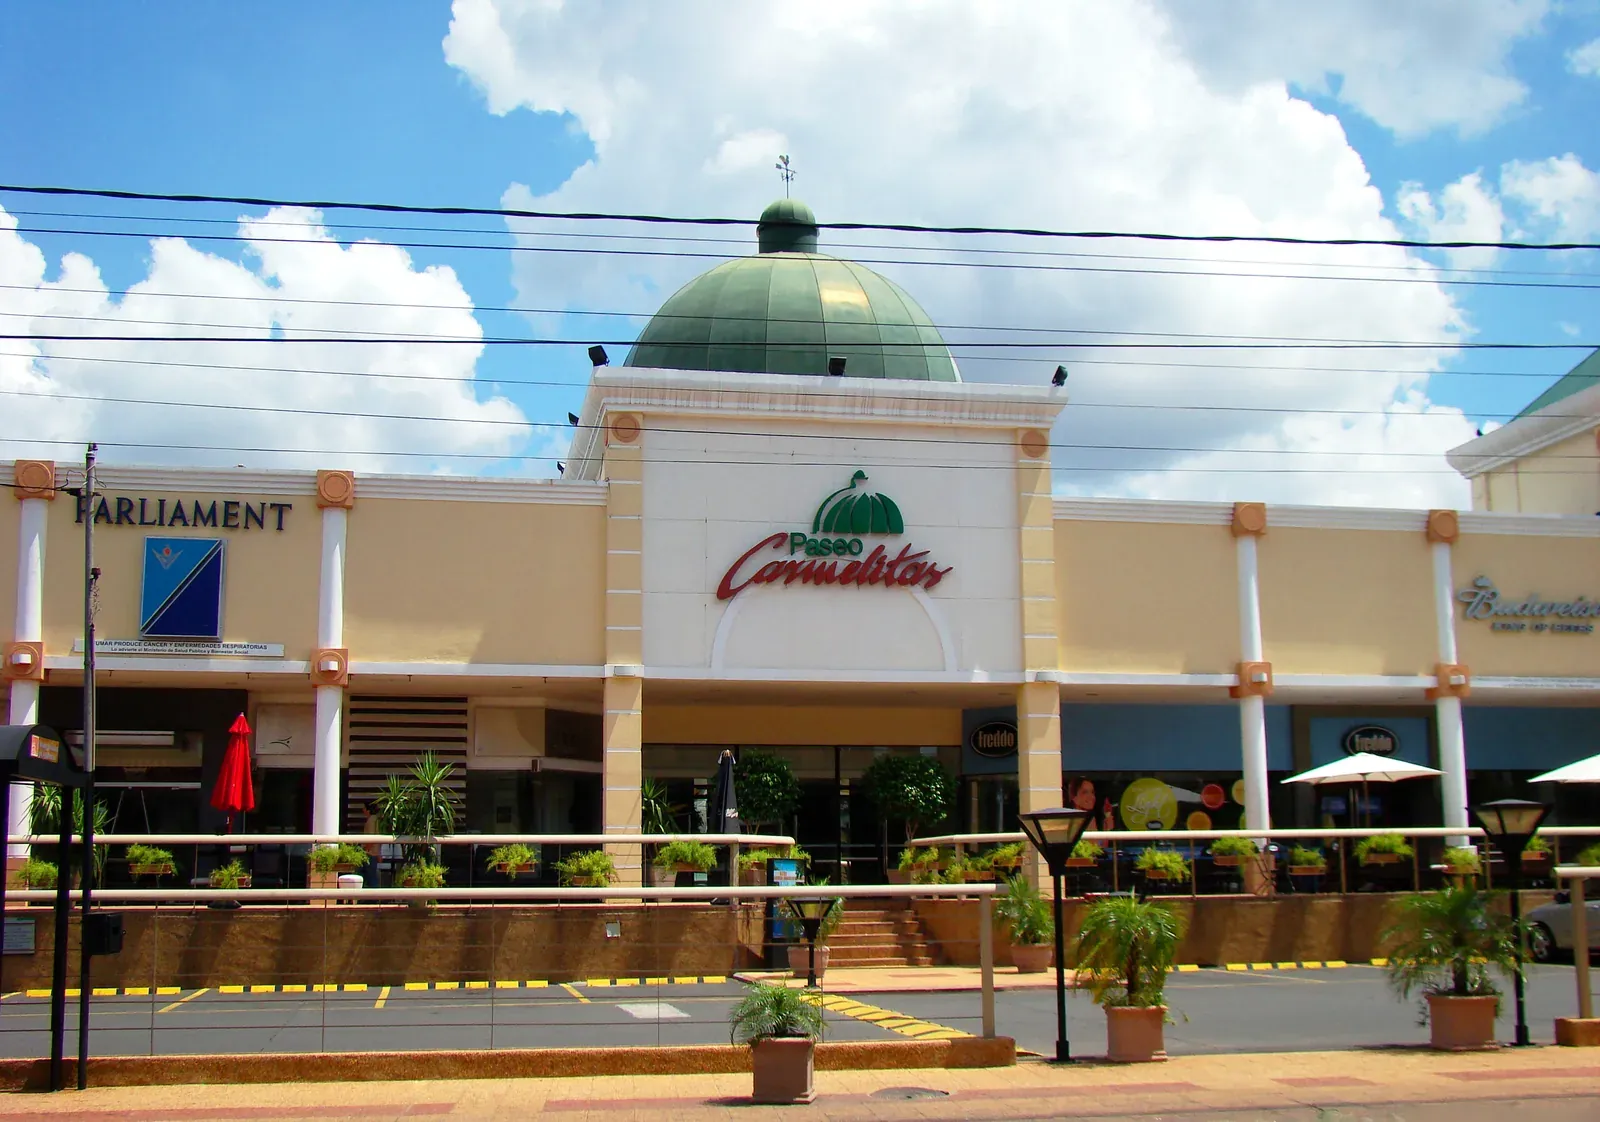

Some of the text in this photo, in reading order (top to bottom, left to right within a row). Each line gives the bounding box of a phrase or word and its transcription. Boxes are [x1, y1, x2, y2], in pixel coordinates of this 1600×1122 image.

[790, 532, 864, 556] Paseo
[716, 532, 953, 600] Carmelitas
[979, 729, 1014, 748] Freddo
